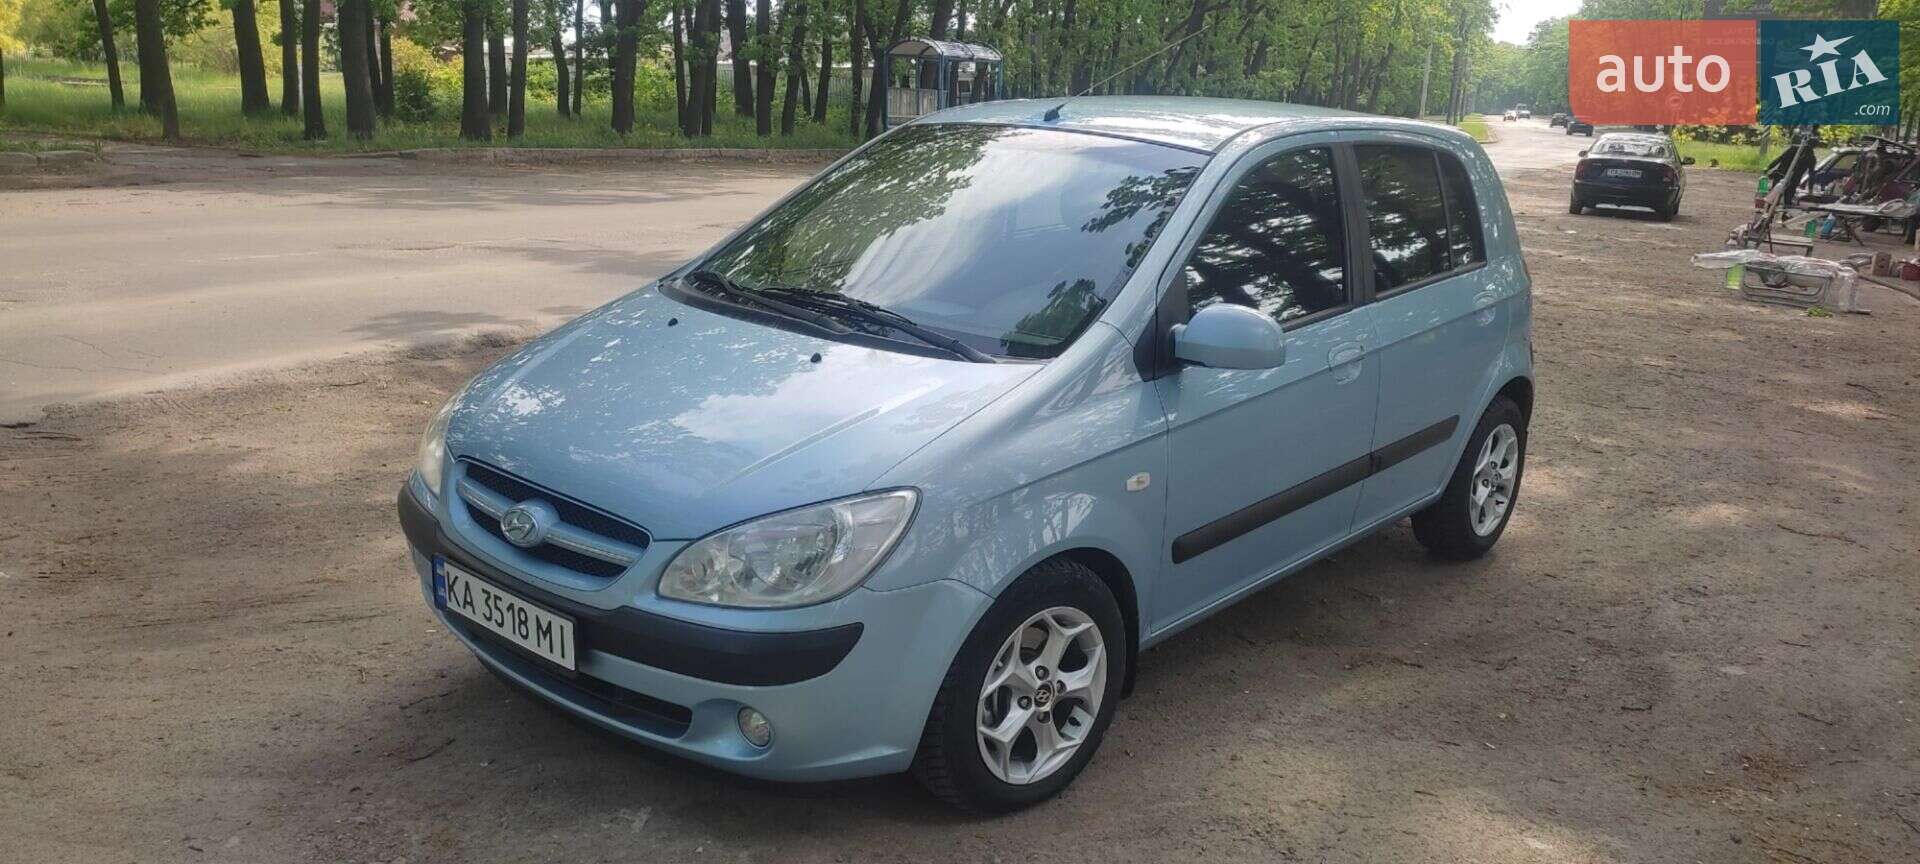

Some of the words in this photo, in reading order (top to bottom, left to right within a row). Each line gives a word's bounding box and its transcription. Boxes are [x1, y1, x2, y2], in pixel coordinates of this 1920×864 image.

[446, 570, 476, 616] KA
[481, 587, 530, 641] 3518
[535, 613, 566, 660] MI
